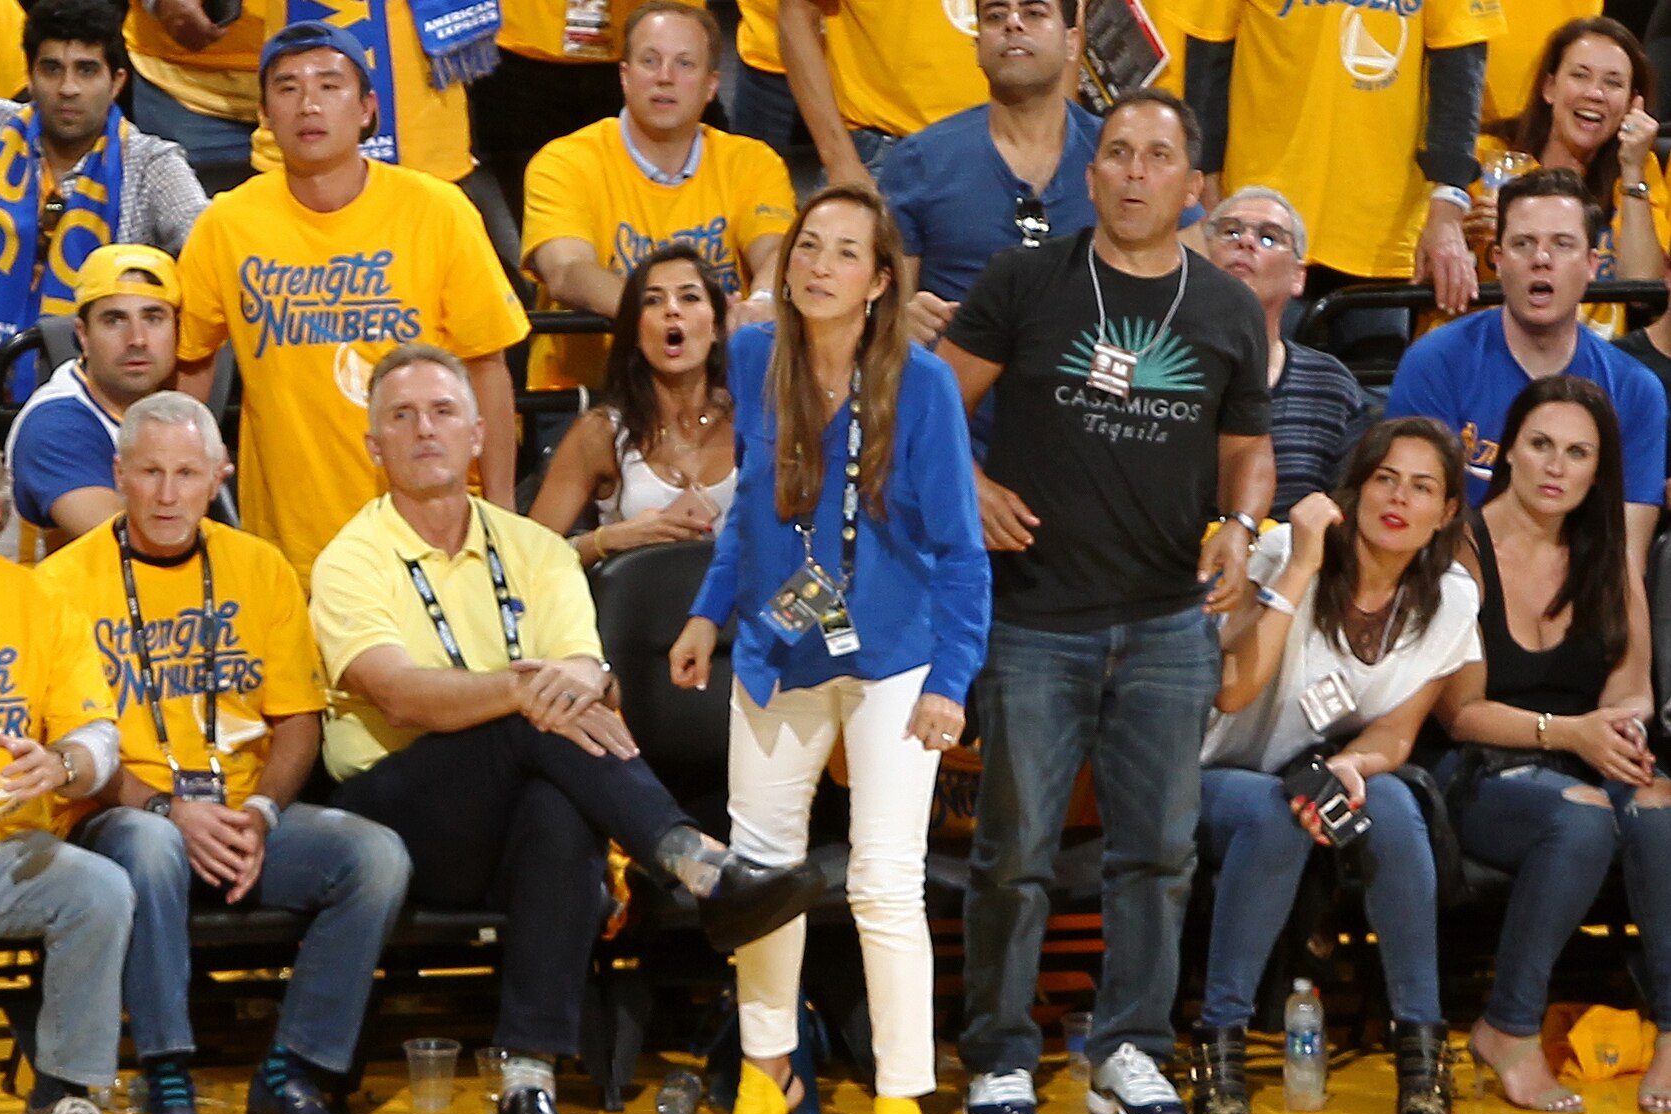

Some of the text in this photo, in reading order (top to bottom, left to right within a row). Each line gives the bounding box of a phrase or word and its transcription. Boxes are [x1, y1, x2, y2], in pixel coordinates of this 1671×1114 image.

[423, 0, 498, 32] AMERICAN
[239, 250, 394, 323] Strength
[254, 297, 422, 358] NUMBERS
[1082, 412, 1169, 443] Tequila
